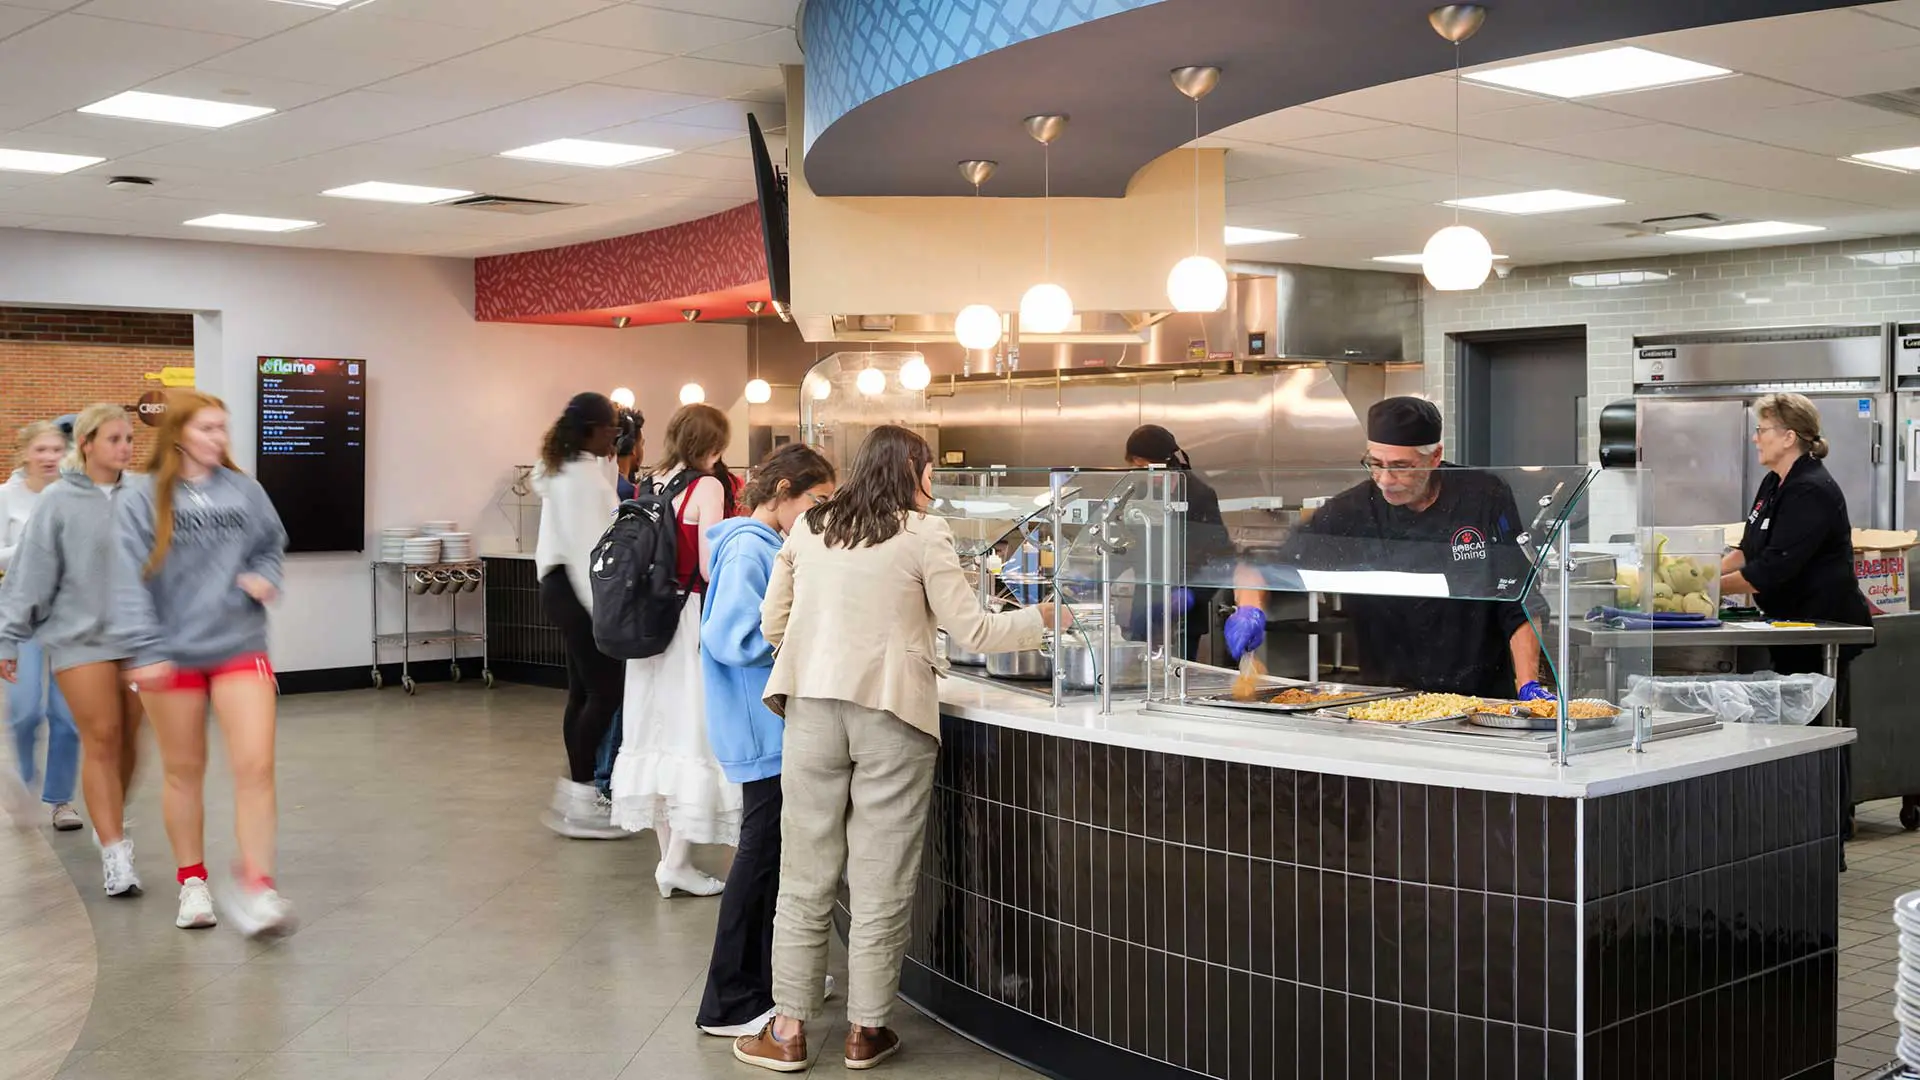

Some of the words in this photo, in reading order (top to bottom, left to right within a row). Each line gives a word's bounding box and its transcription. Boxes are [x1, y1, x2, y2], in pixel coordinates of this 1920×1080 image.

[273, 359, 316, 373] flame
[1452, 541, 1486, 553] BOBCAT
[1453, 549, 1486, 561] Dining
[1855, 557, 1904, 578] EACOCK
